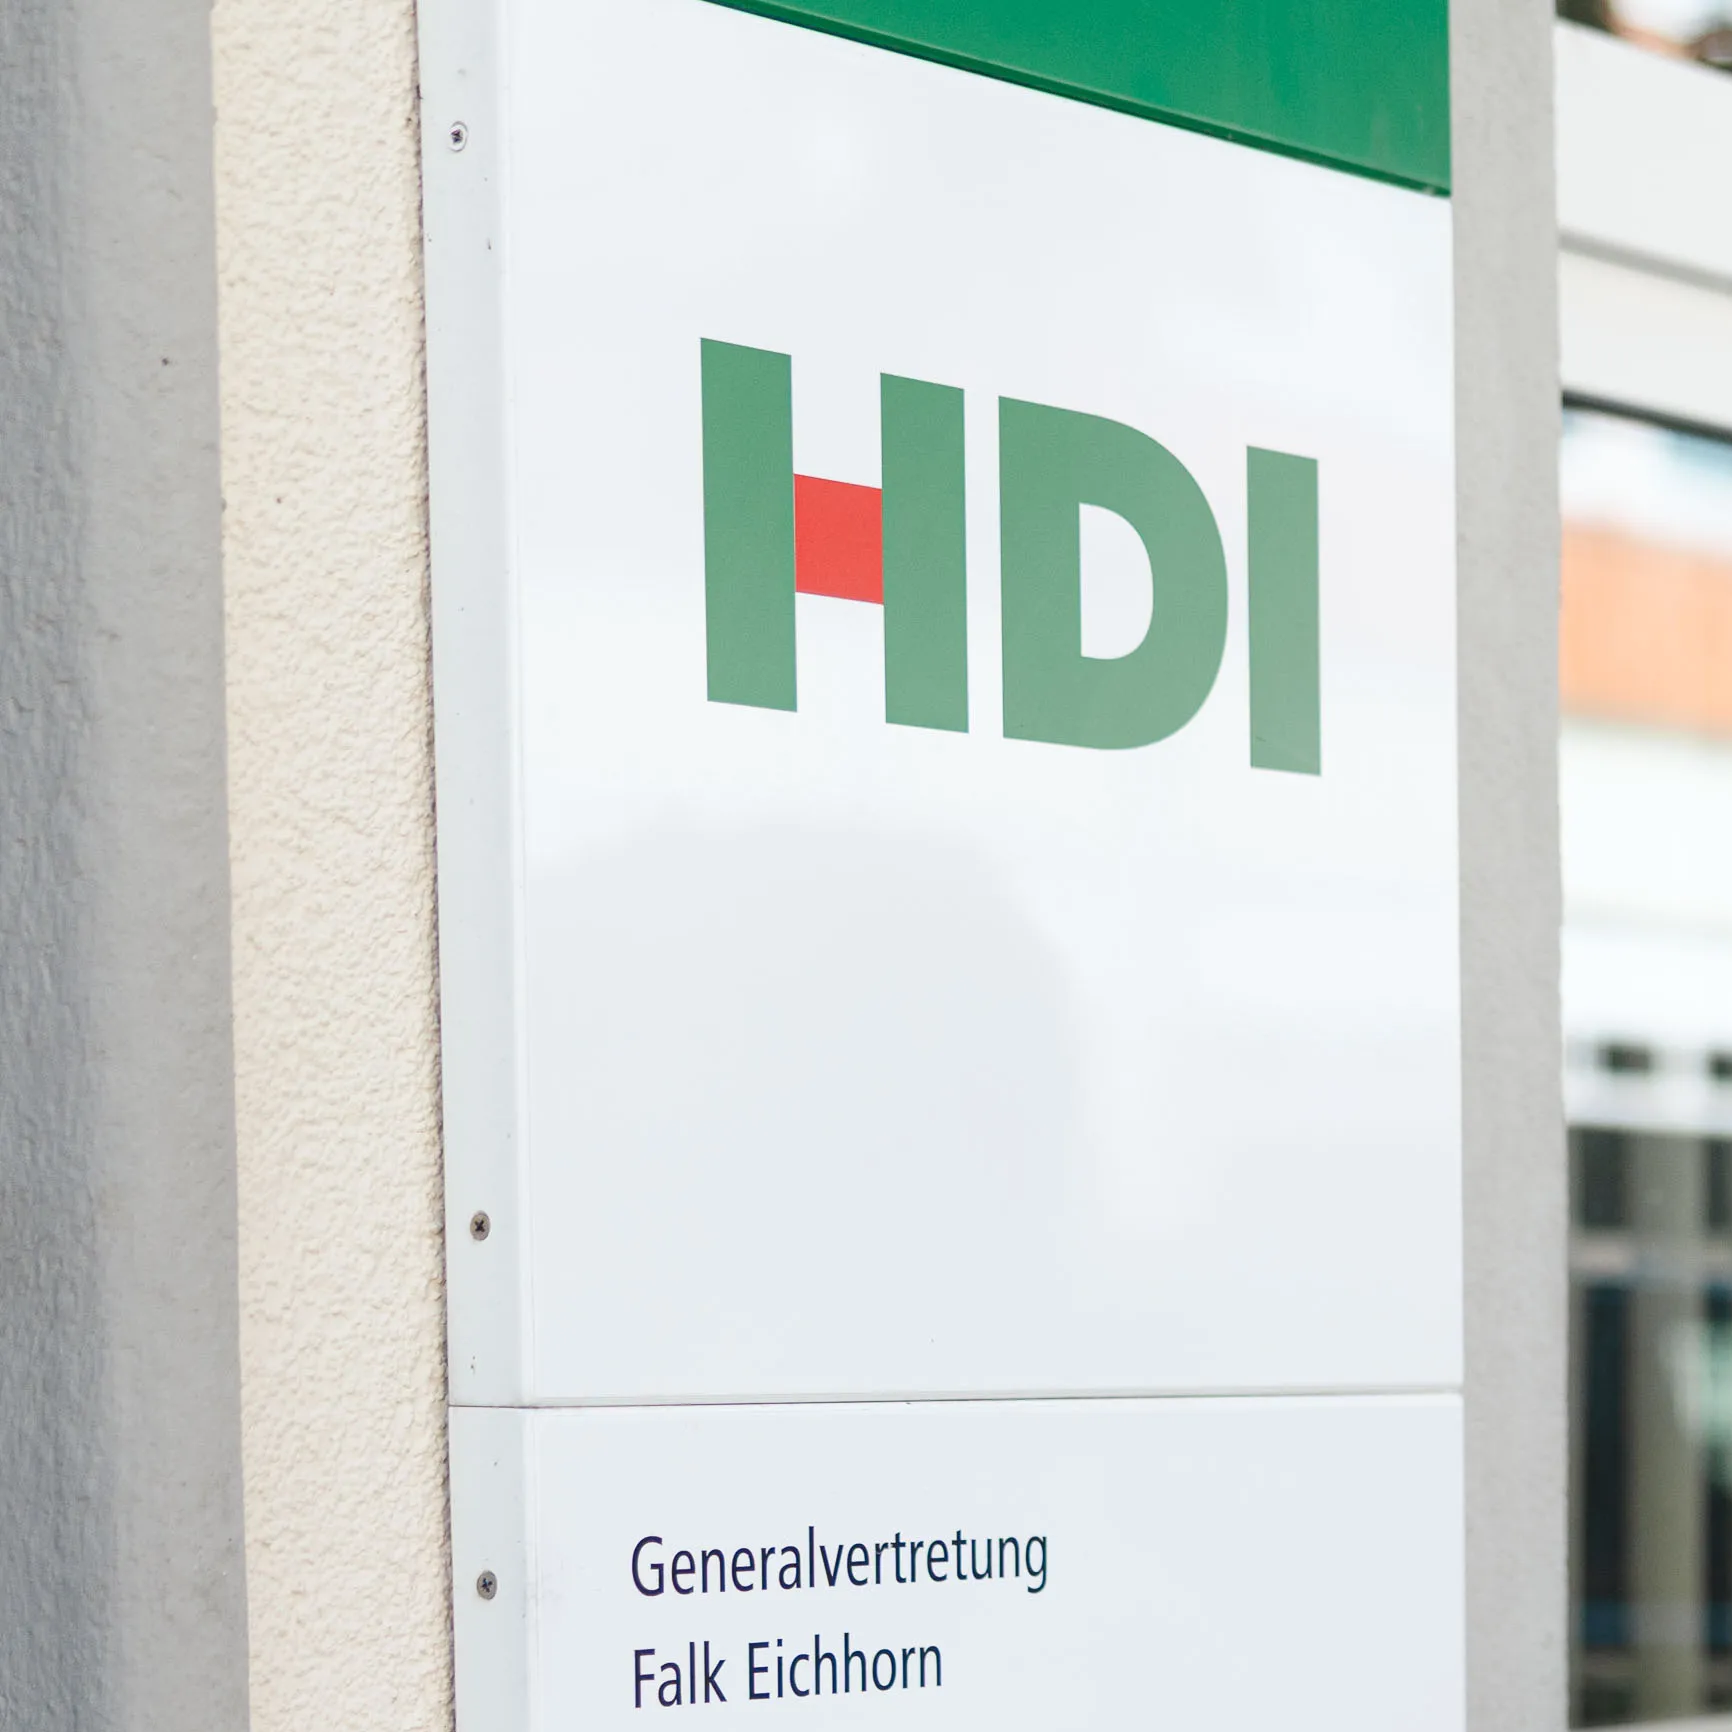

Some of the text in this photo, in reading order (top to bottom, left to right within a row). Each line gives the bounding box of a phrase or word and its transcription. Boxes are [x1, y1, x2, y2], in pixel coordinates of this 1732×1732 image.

[700, 337, 1322, 776] HDI
[631, 1525, 1048, 1597] Generalvertretung
[634, 1632, 943, 1709] Falk Eichhorn
